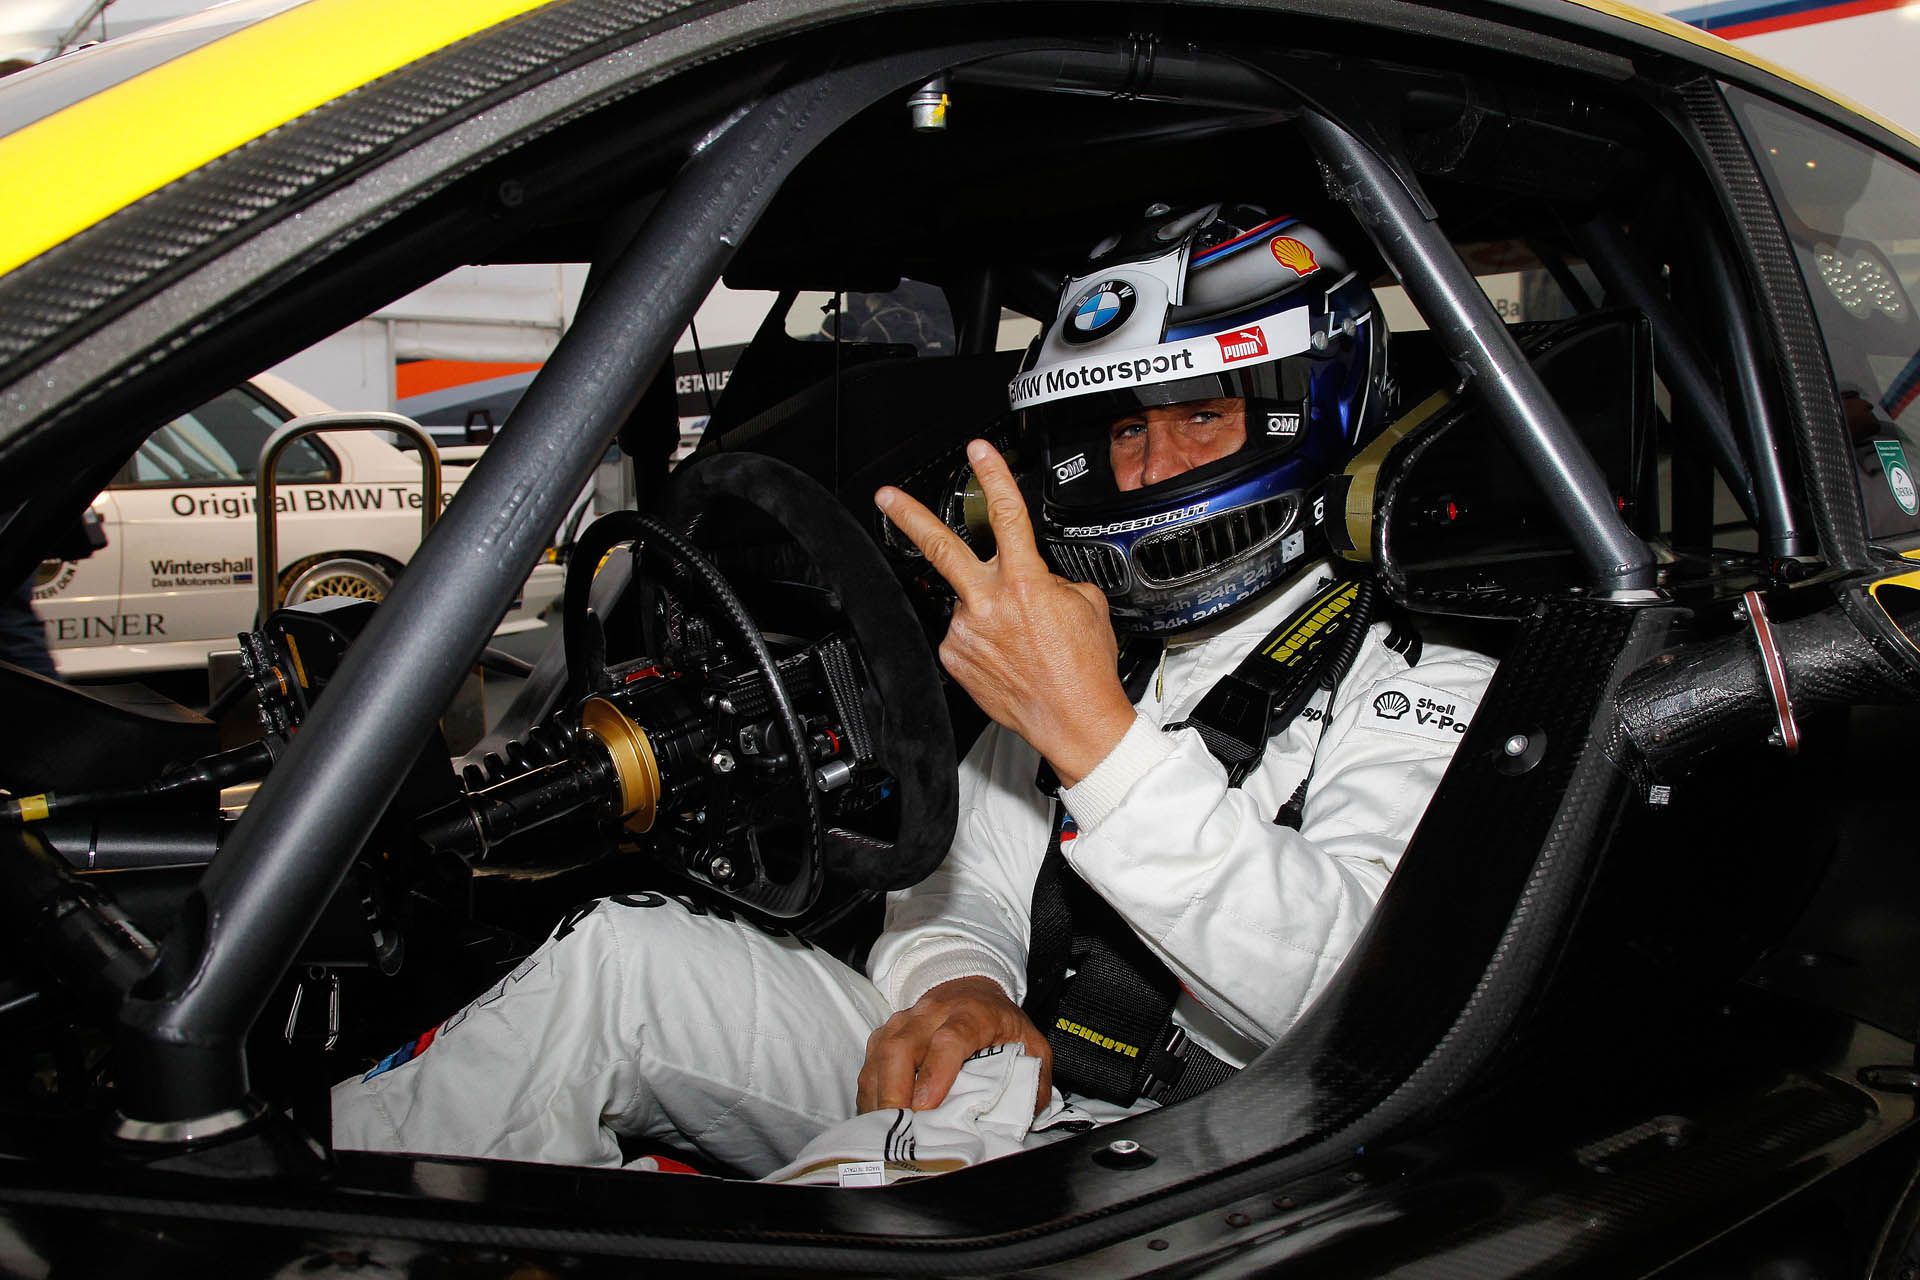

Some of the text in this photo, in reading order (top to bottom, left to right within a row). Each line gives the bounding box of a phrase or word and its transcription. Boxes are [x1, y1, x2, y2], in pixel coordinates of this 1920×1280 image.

[1076, 281, 1134, 308] BMW
[1224, 341, 1259, 359] PUMA
[1011, 349, 1193, 403] BMW Motorsport
[1056, 457, 1087, 480] OMP
[171, 491, 296, 518] Origial
[307, 488, 382, 512] BMW
[1063, 501, 1210, 538] KAOS-DESIGN.IT
[151, 557, 254, 575] Wintershall
[151, 578, 173, 588] Das
[1197, 583, 1236, 605] 24h
[1243, 560, 1278, 585] 24h
[1270, 582, 1360, 663] SCHROT
[1417, 697, 1455, 716] Shell
[1056, 1018, 1139, 1058] SCHROTH
